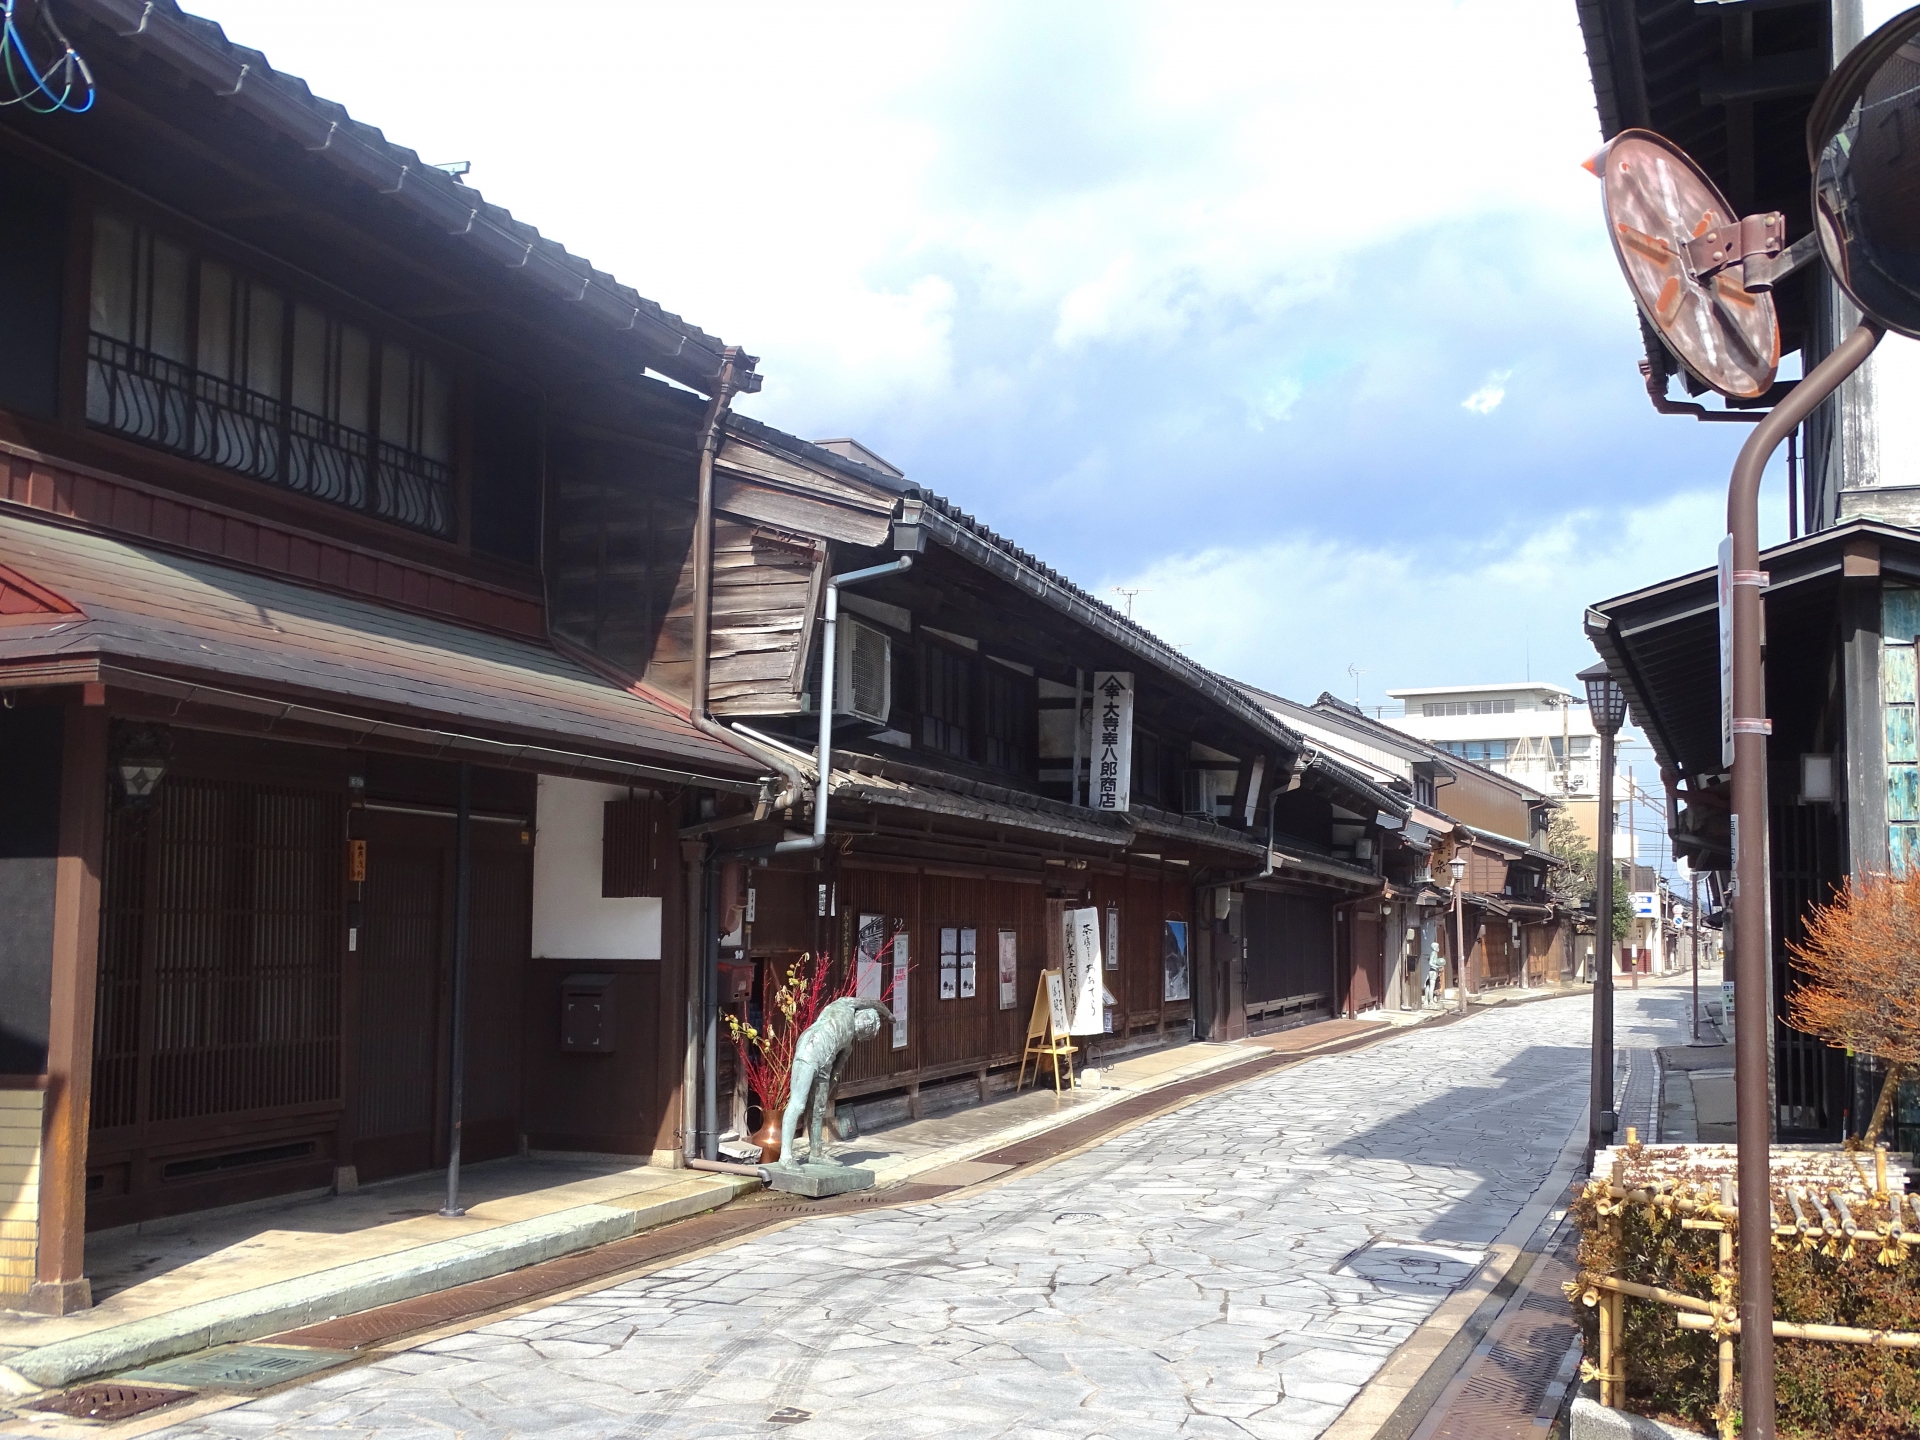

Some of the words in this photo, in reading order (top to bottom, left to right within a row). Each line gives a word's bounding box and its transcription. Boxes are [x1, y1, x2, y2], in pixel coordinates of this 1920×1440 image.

[1098, 701, 1120, 809] 大寺幸八郎商店
